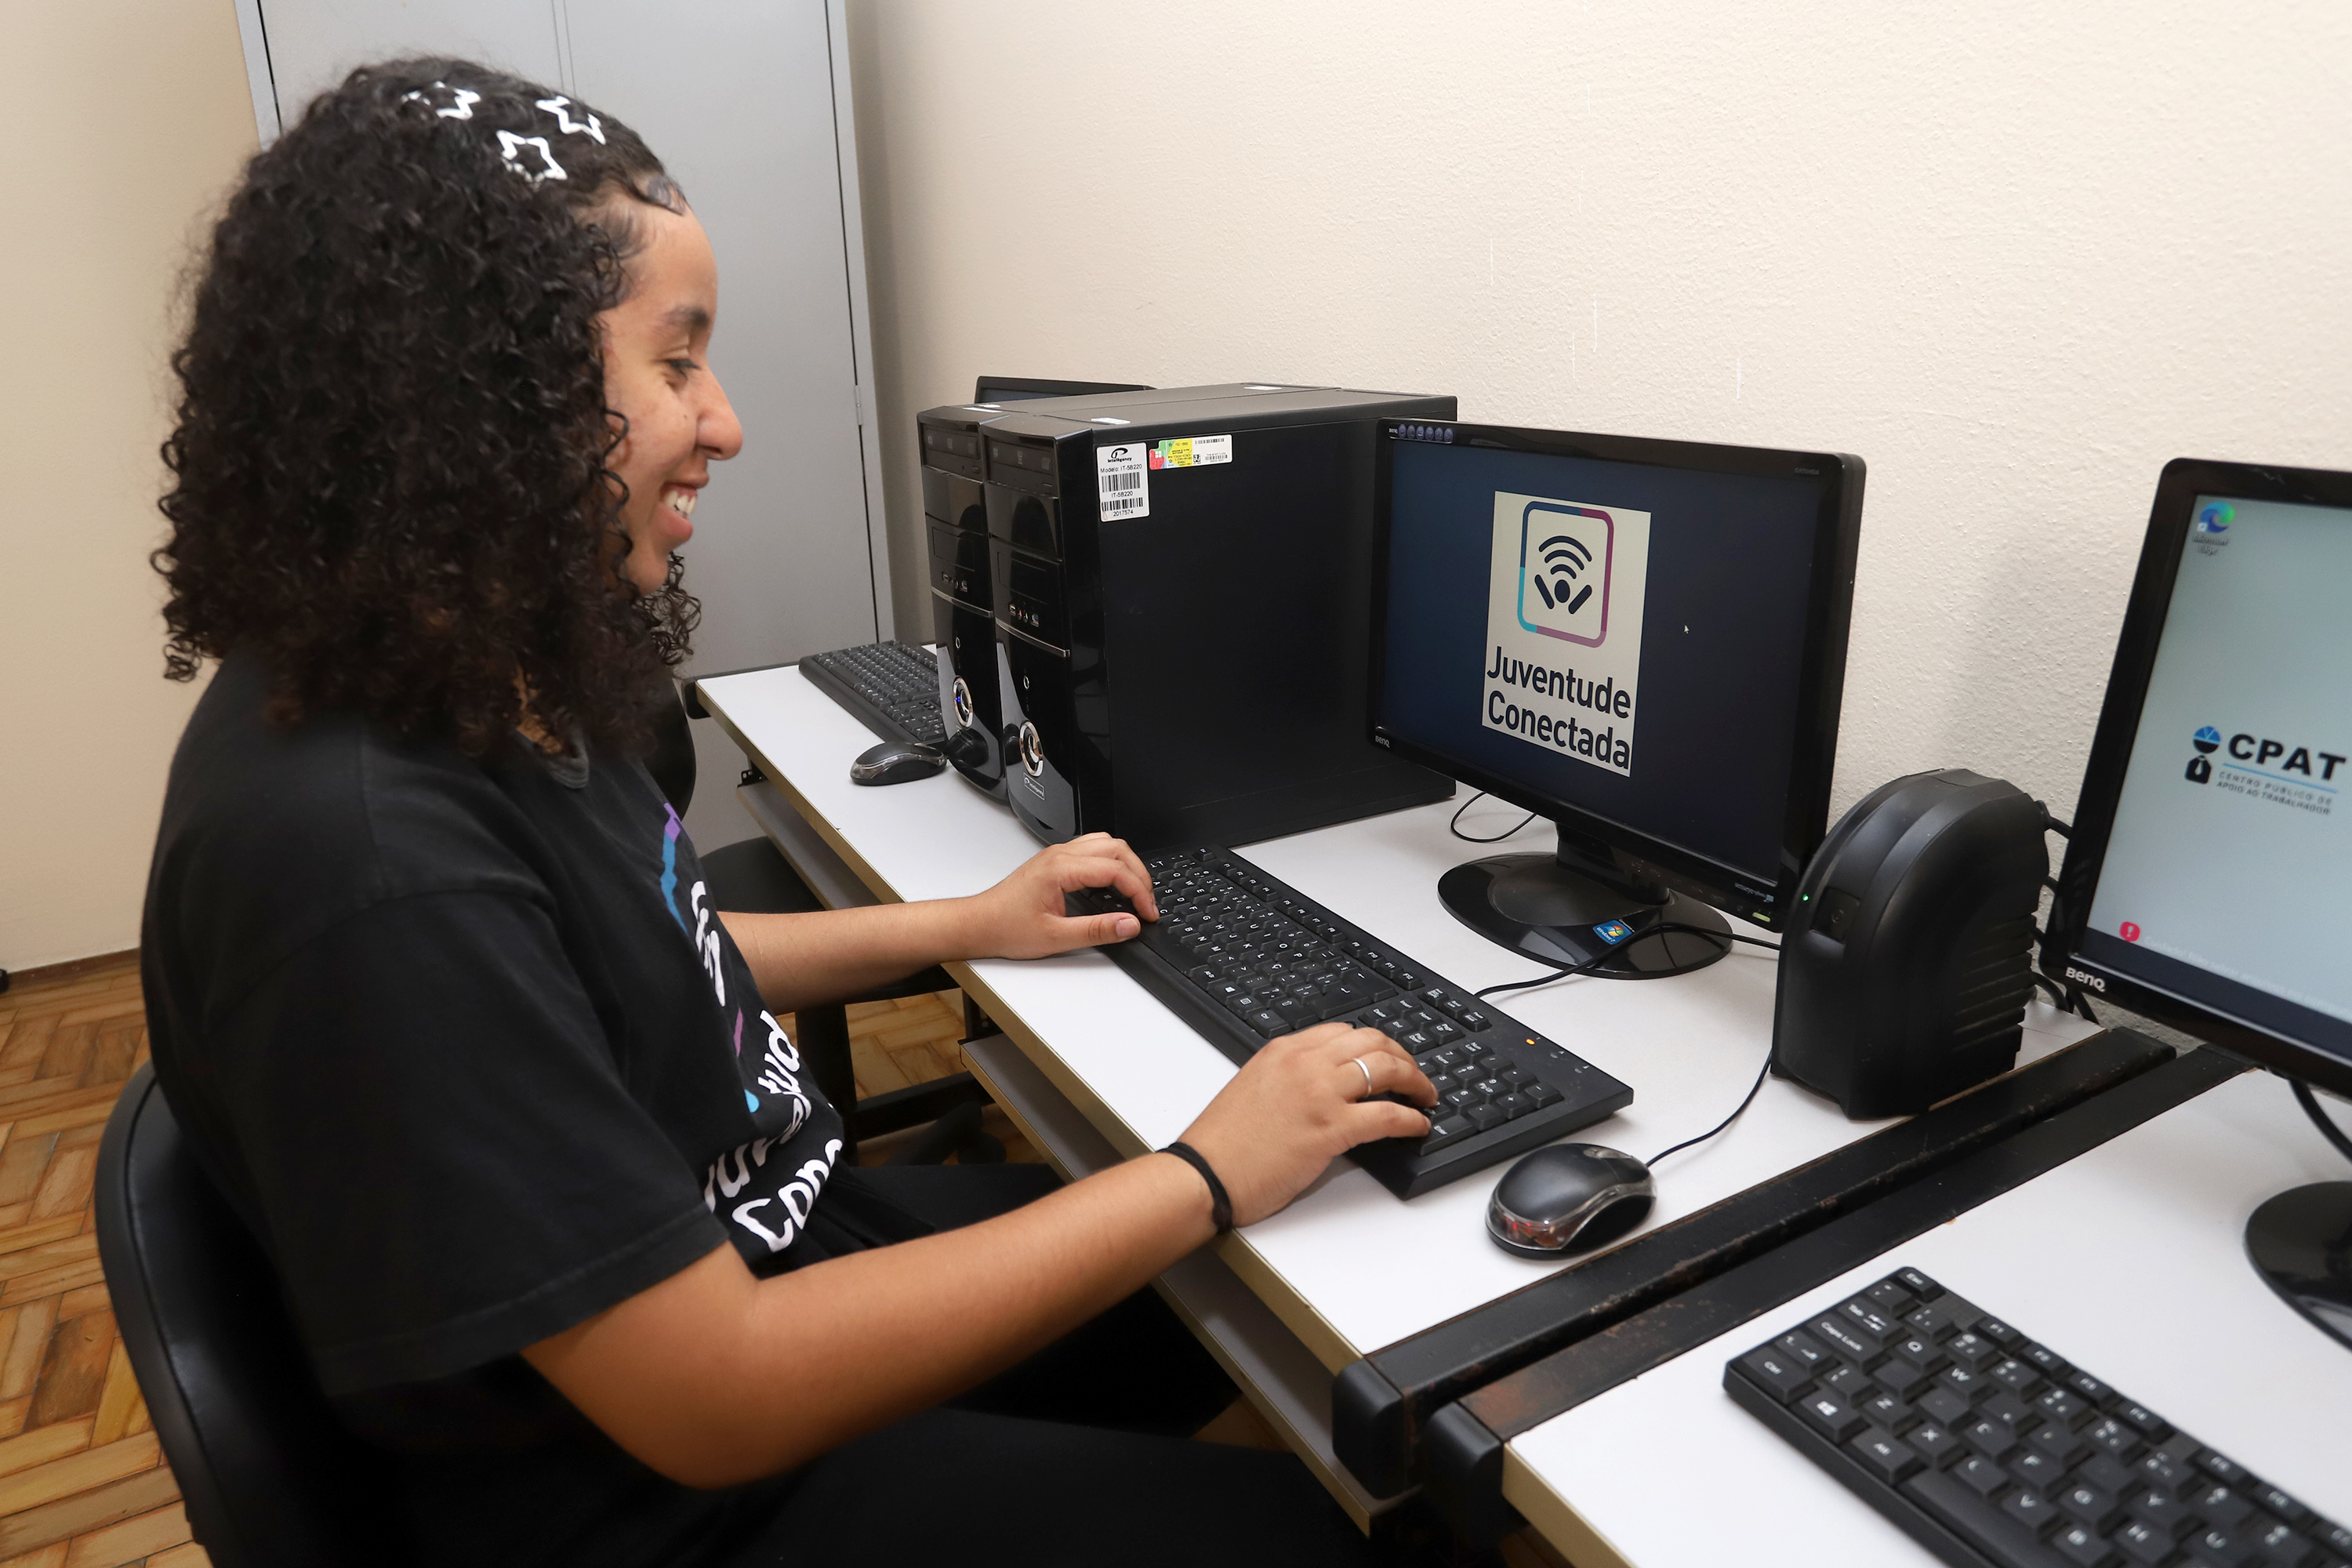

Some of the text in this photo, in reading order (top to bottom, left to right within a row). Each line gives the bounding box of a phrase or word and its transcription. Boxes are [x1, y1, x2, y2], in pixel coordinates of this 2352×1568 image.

[1486, 646, 1631, 719] Juventude
[1488, 690, 1630, 770] Conectada
[1375, 735, 1390, 748] BenQ
[2228, 733, 2347, 781] CPAT
[2219, 771, 2259, 788] CENTRO
[2216, 781, 2331, 815] APOIO AO TRABALHADOR
[1597, 927, 1612, 940] Windows
[2065, 967, 2107, 993] BenQ
[1436, 1055, 1449, 1064] Home
[1906, 1272, 1923, 1285] Esc
[1849, 1304, 1864, 1316] Tab
[1821, 1322, 1863, 1352] Caps Lock
[1907, 1341, 1922, 1352] Q
[1764, 1361, 1783, 1374] Ctrl
[1951, 1368, 1971, 1381] W
